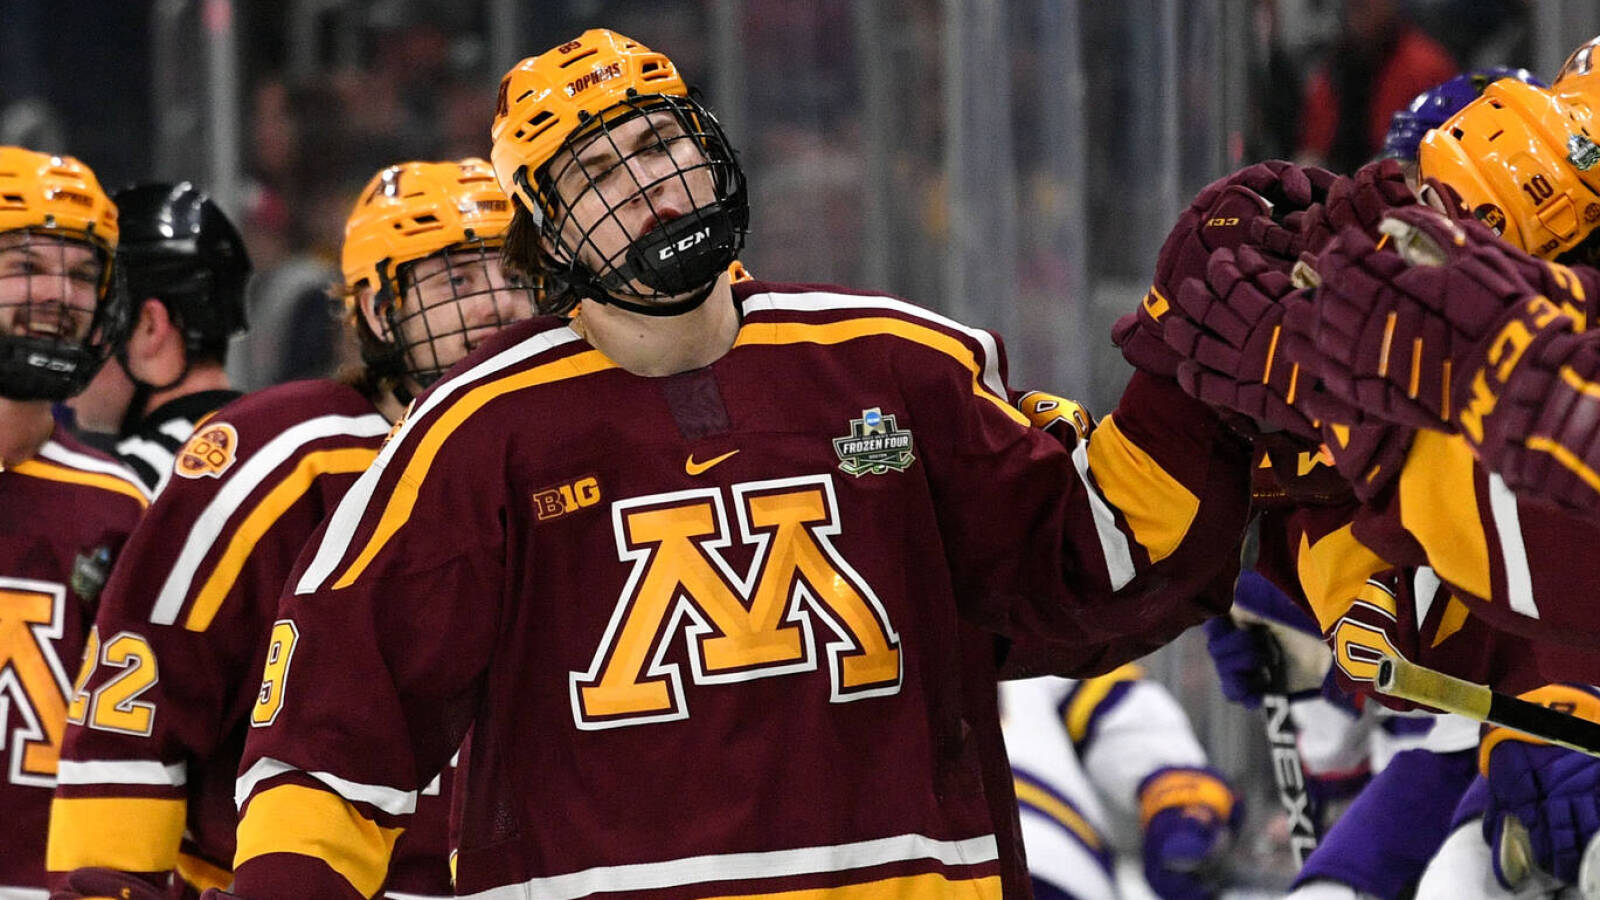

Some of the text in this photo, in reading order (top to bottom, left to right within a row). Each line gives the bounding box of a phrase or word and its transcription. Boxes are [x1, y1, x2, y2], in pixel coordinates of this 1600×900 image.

[565, 63, 621, 96] GOPHRS
[1523, 173, 1554, 206] 10
[843, 439, 883, 454] FROZEN
[884, 436, 909, 449] FOUR
[569, 474, 903, 730] M
